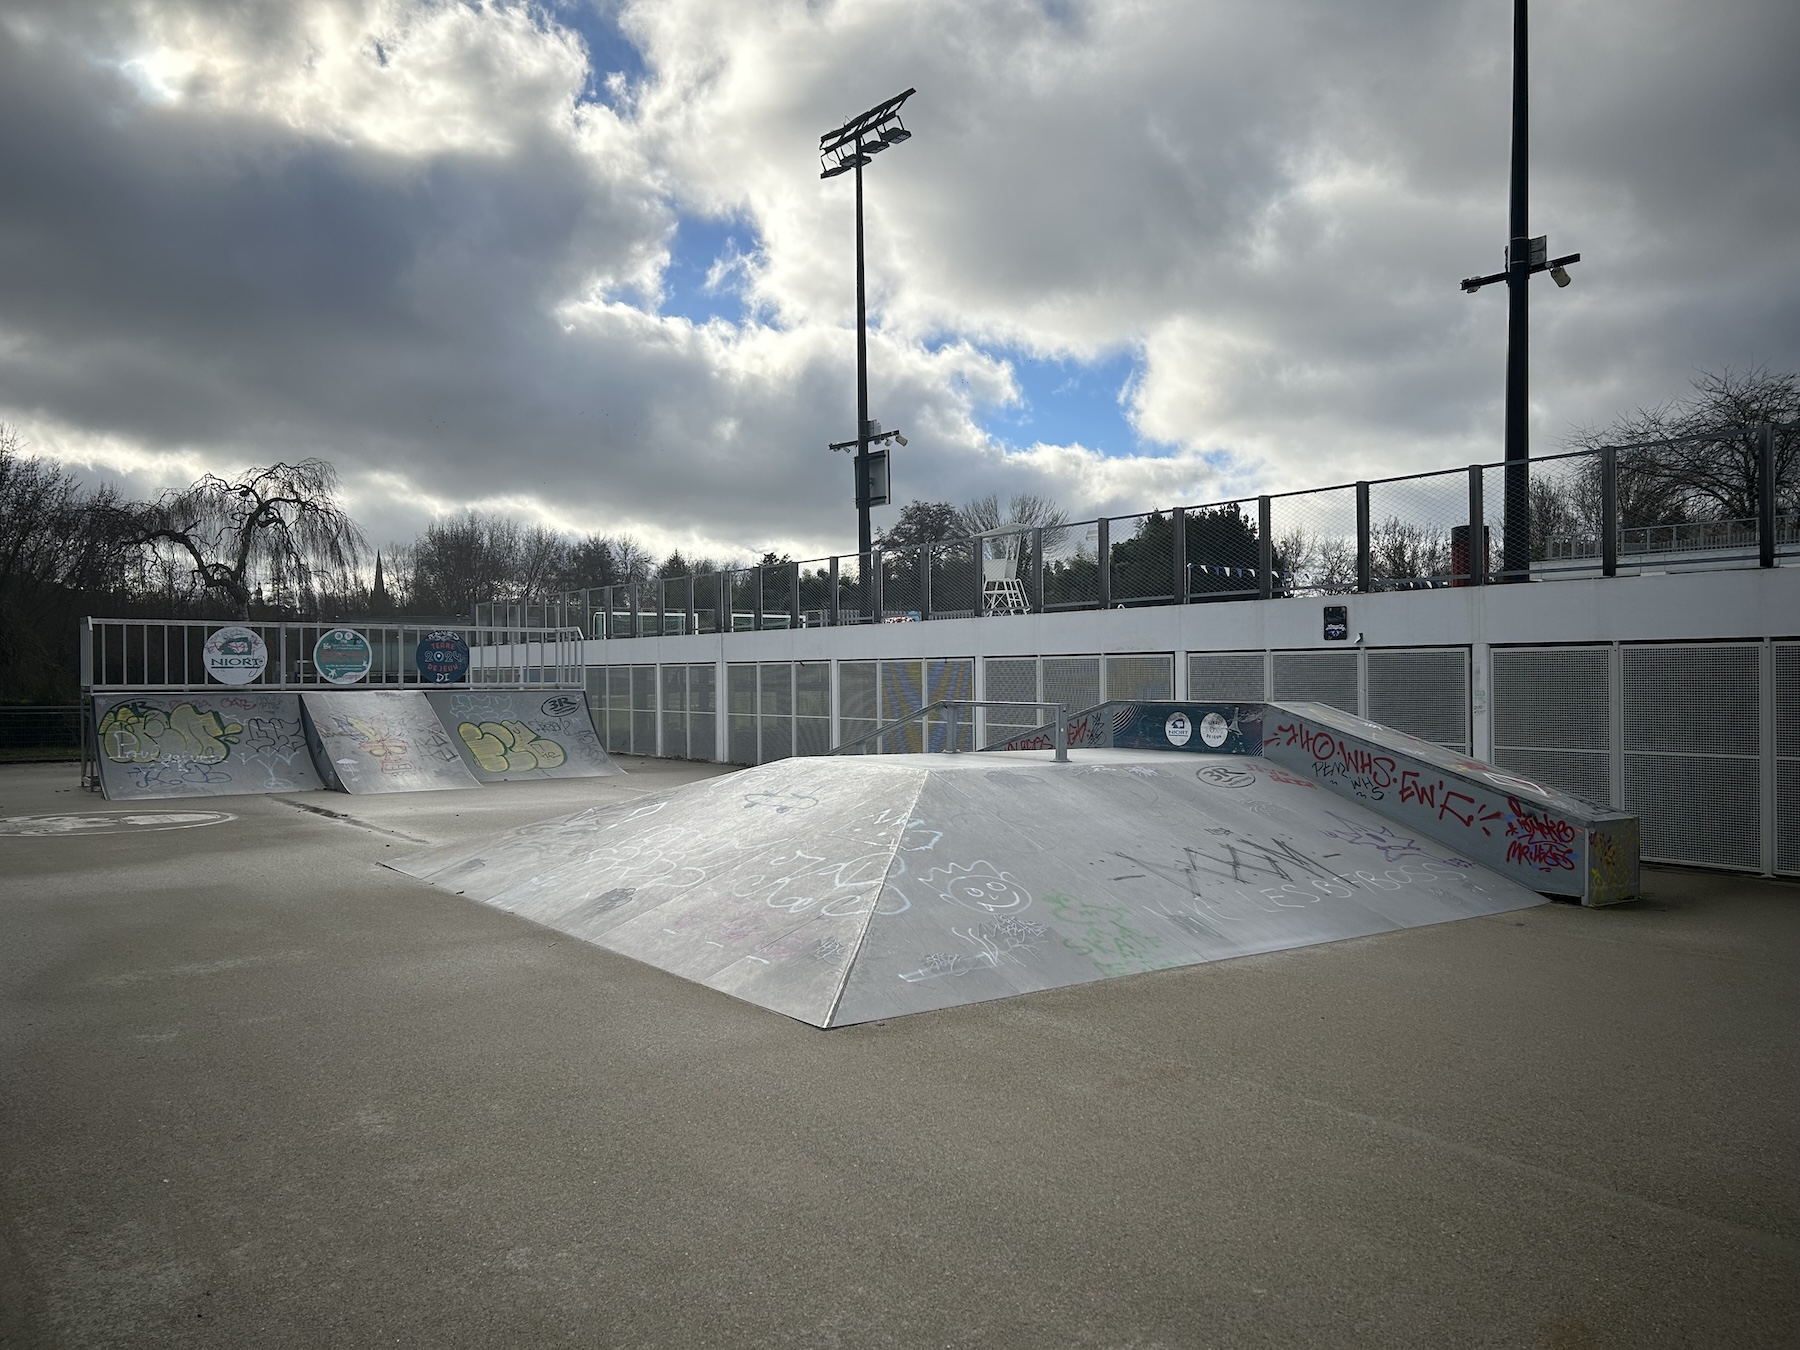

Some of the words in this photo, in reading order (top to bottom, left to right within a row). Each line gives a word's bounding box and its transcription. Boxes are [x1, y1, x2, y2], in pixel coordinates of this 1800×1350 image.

[430, 642, 455, 650] TERRE
[424, 650, 462, 663] 2024
[211, 658, 260, 666] NIORT
[427, 663, 438, 672] DE
